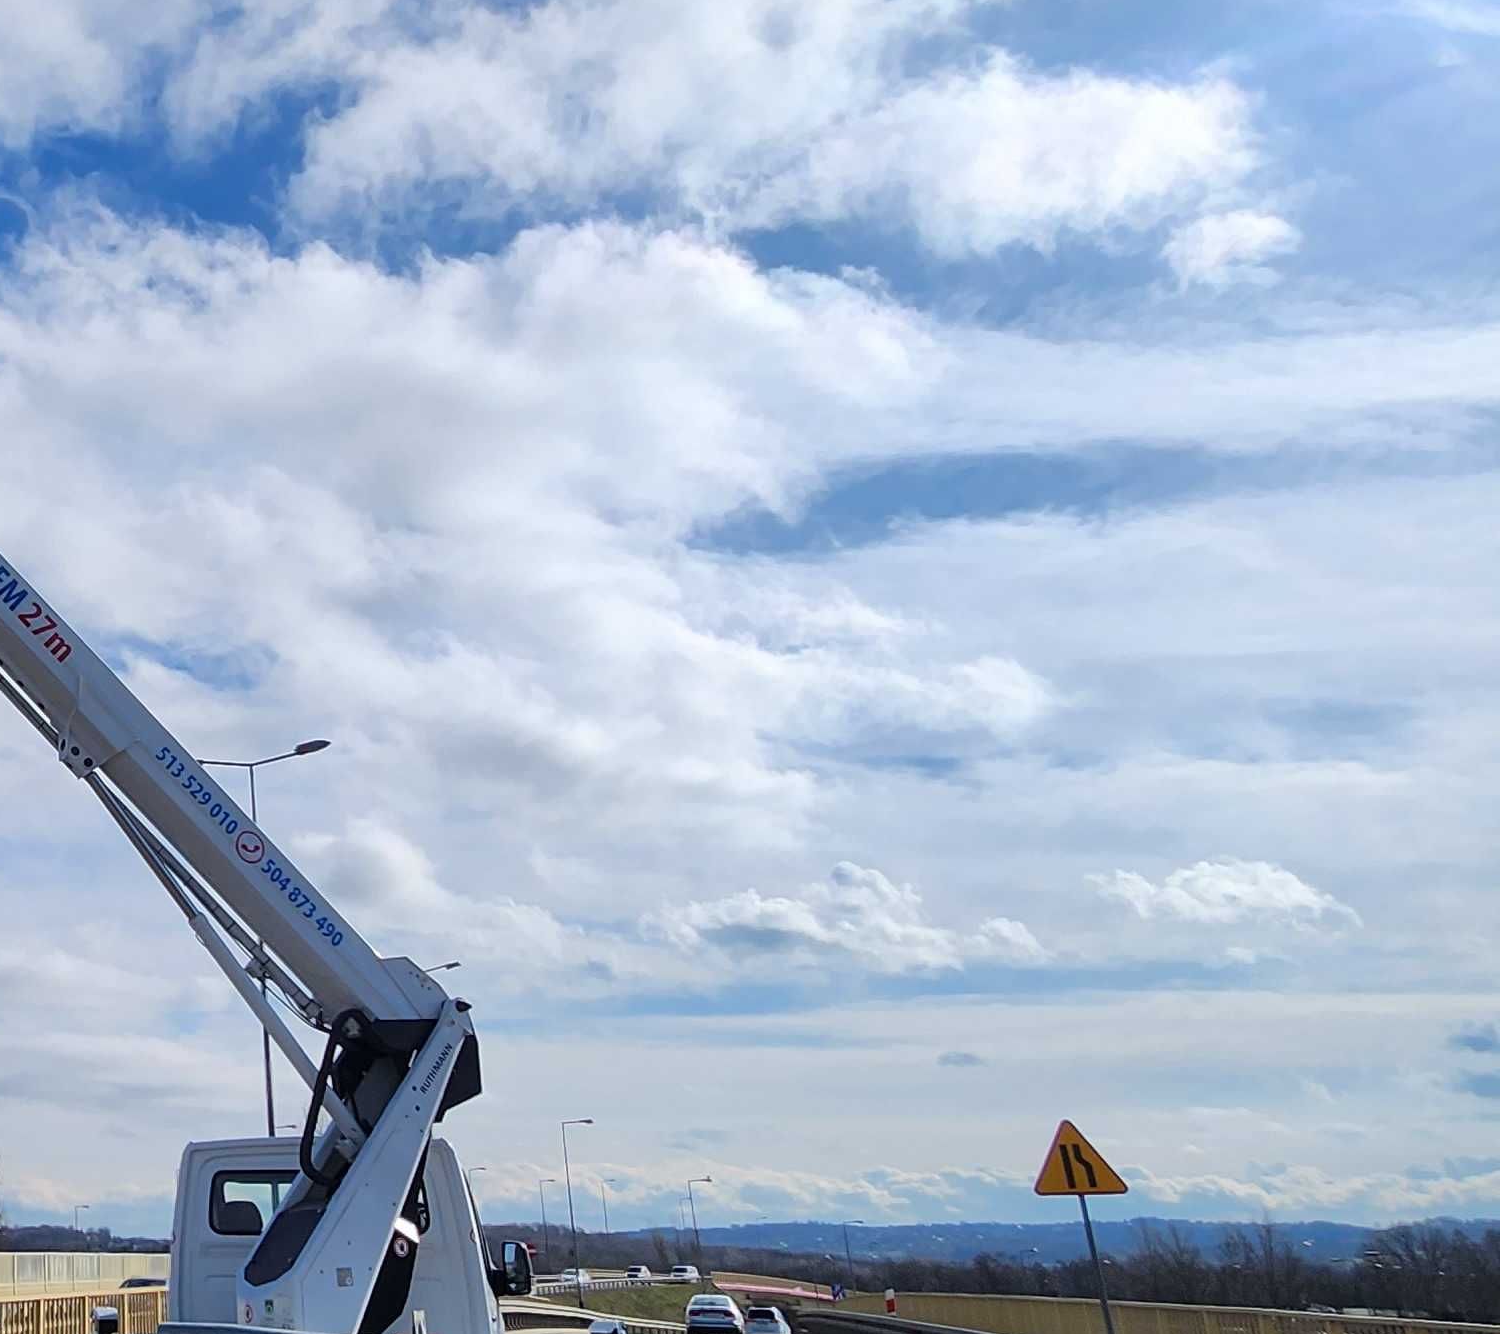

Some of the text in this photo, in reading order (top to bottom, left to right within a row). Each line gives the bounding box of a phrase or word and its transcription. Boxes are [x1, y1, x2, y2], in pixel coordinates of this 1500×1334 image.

[18, 602, 73, 663] 27m
[155, 746, 238, 835] 513 529 010
[261, 859, 344, 947] 504 873 490
